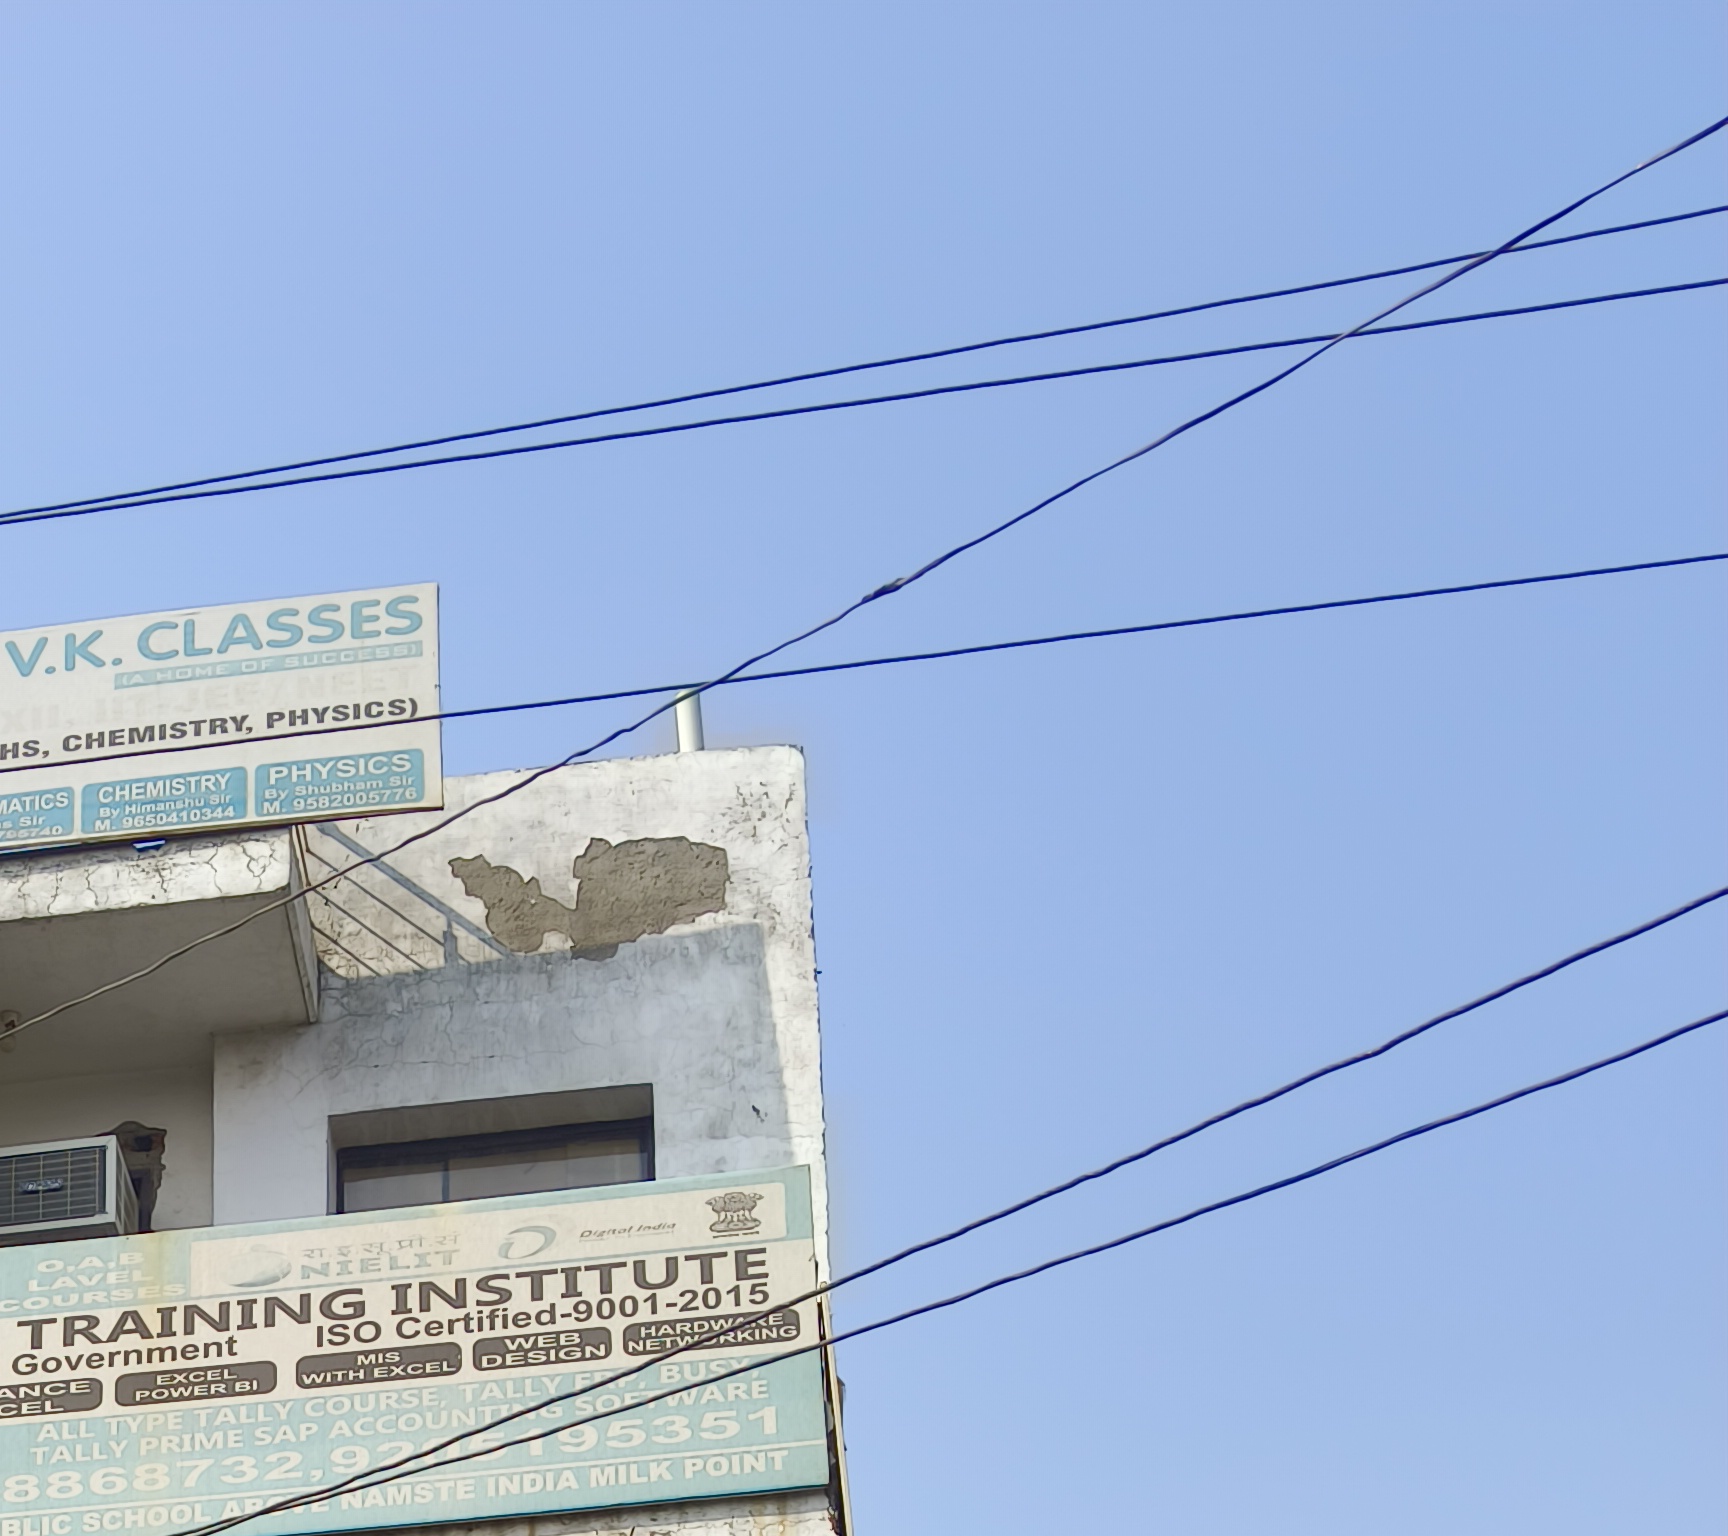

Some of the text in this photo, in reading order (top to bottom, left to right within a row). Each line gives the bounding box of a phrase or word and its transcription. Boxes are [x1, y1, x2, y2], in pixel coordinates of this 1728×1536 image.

[6, 594, 423, 678] V.K. CLASSES
[62, 713, 253, 753] CHEMISTRY,
[266, 697, 419, 729] PHYSICS)
[98, 772, 231, 804] CHEMISTRY
[269, 753, 412, 786] PHYSICS
[12, 1334, 238, 1376] Government
[316, 1320, 382, 1348] ISO
[395, 1283, 770, 1340] Certified-9001-2015
[17, 1287, 366, 1351] TRAINING
[391, 1247, 770, 1317] INSTITUTE
